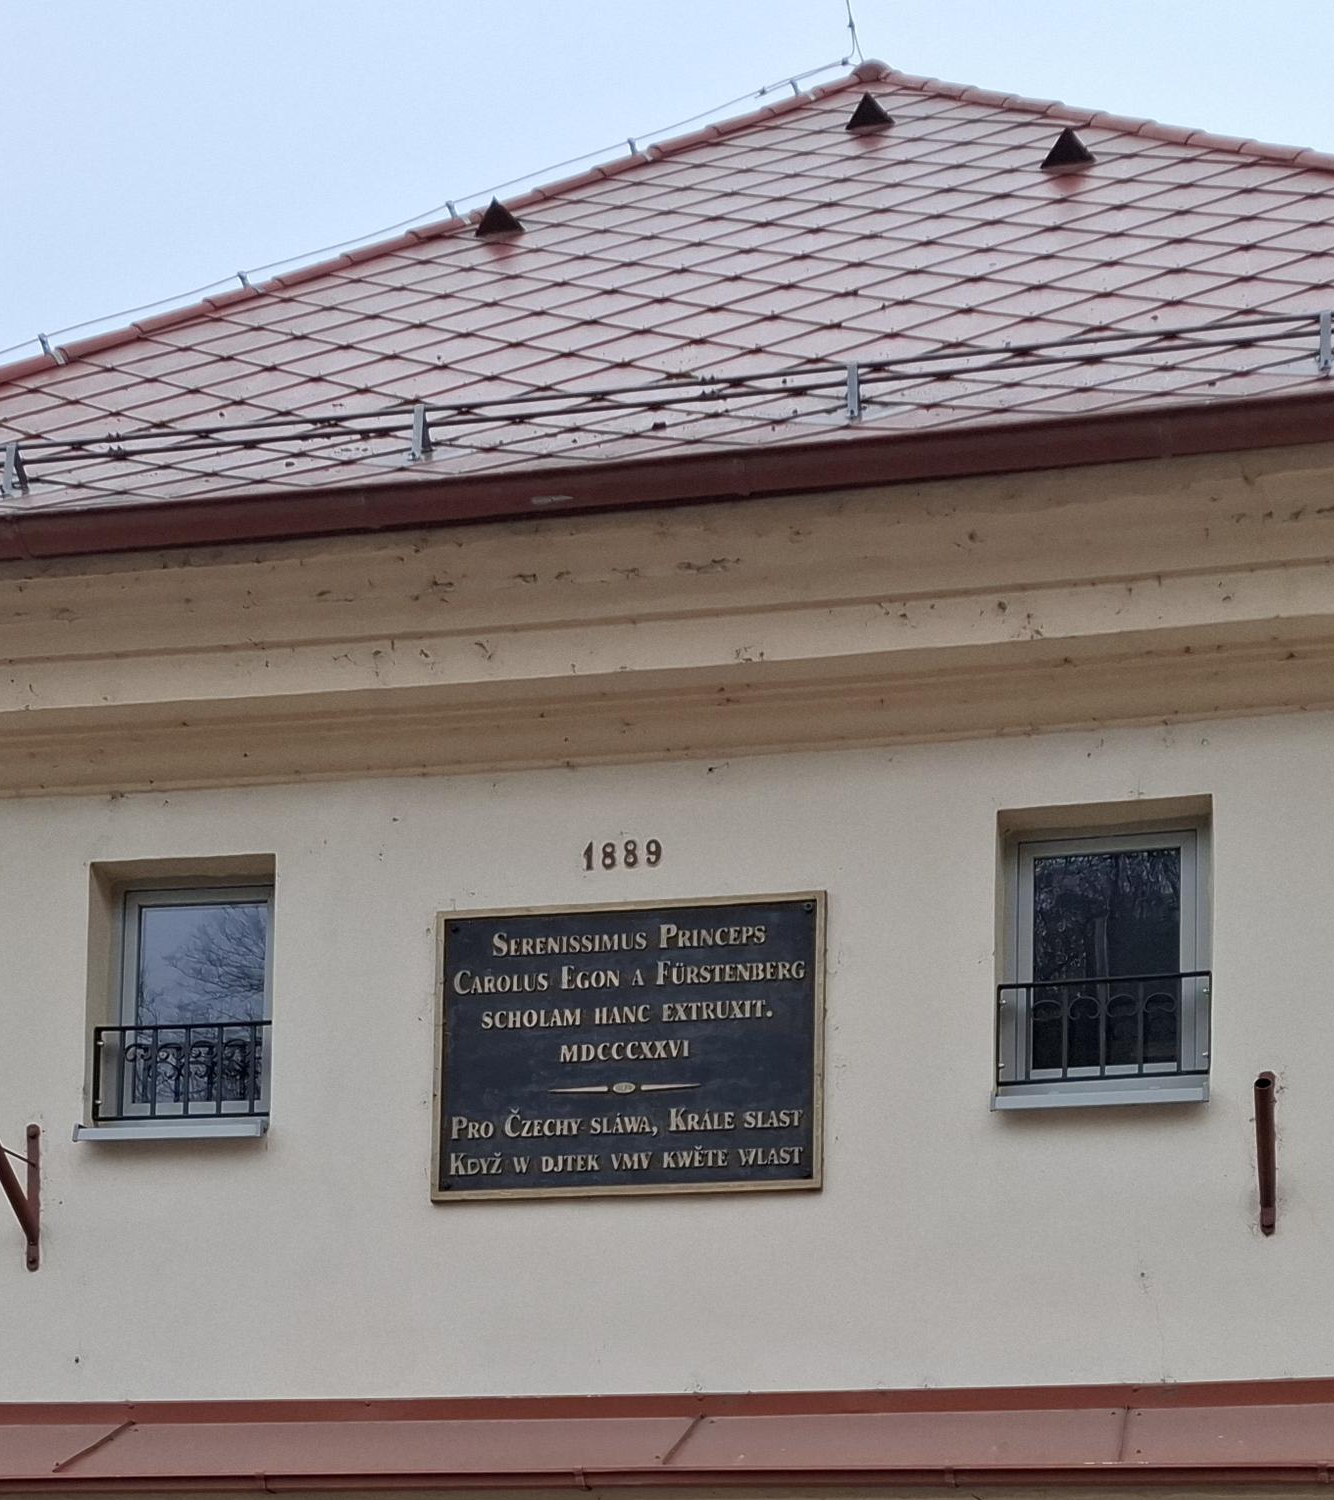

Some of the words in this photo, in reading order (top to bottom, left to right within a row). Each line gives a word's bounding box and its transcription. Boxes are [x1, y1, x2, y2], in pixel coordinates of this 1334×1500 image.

[583, 839, 662, 870] 1889
[492, 931, 647, 957] SERENISSIMUS
[660, 924, 767, 949] PRINCEPS
[453, 969, 548, 995] CAROLUS
[561, 966, 620, 990] EGON
[631, 972, 644, 986] A
[656, 959, 806, 985] FÜRSTENBERG
[481, 1009, 581, 1029] SCHOLAM
[595, 1006, 650, 1025] HANC
[662, 1000, 773, 1021] EXTRUXIT.
[560, 1040, 690, 1063] MDCCCXXVI
[451, 1116, 494, 1140] PRO
[504, 1109, 588, 1137] ČZECHY
[669, 1107, 735, 1131] KRÁLE
[743, 1109, 803, 1128] SLAST
[449, 1151, 502, 1175] KDYŽ
[513, 1157, 530, 1173] W
[541, 1155, 600, 1173] DJTEK
[663, 1147, 728, 1168] KWĚTE
[738, 1147, 803, 1166] WLAST
